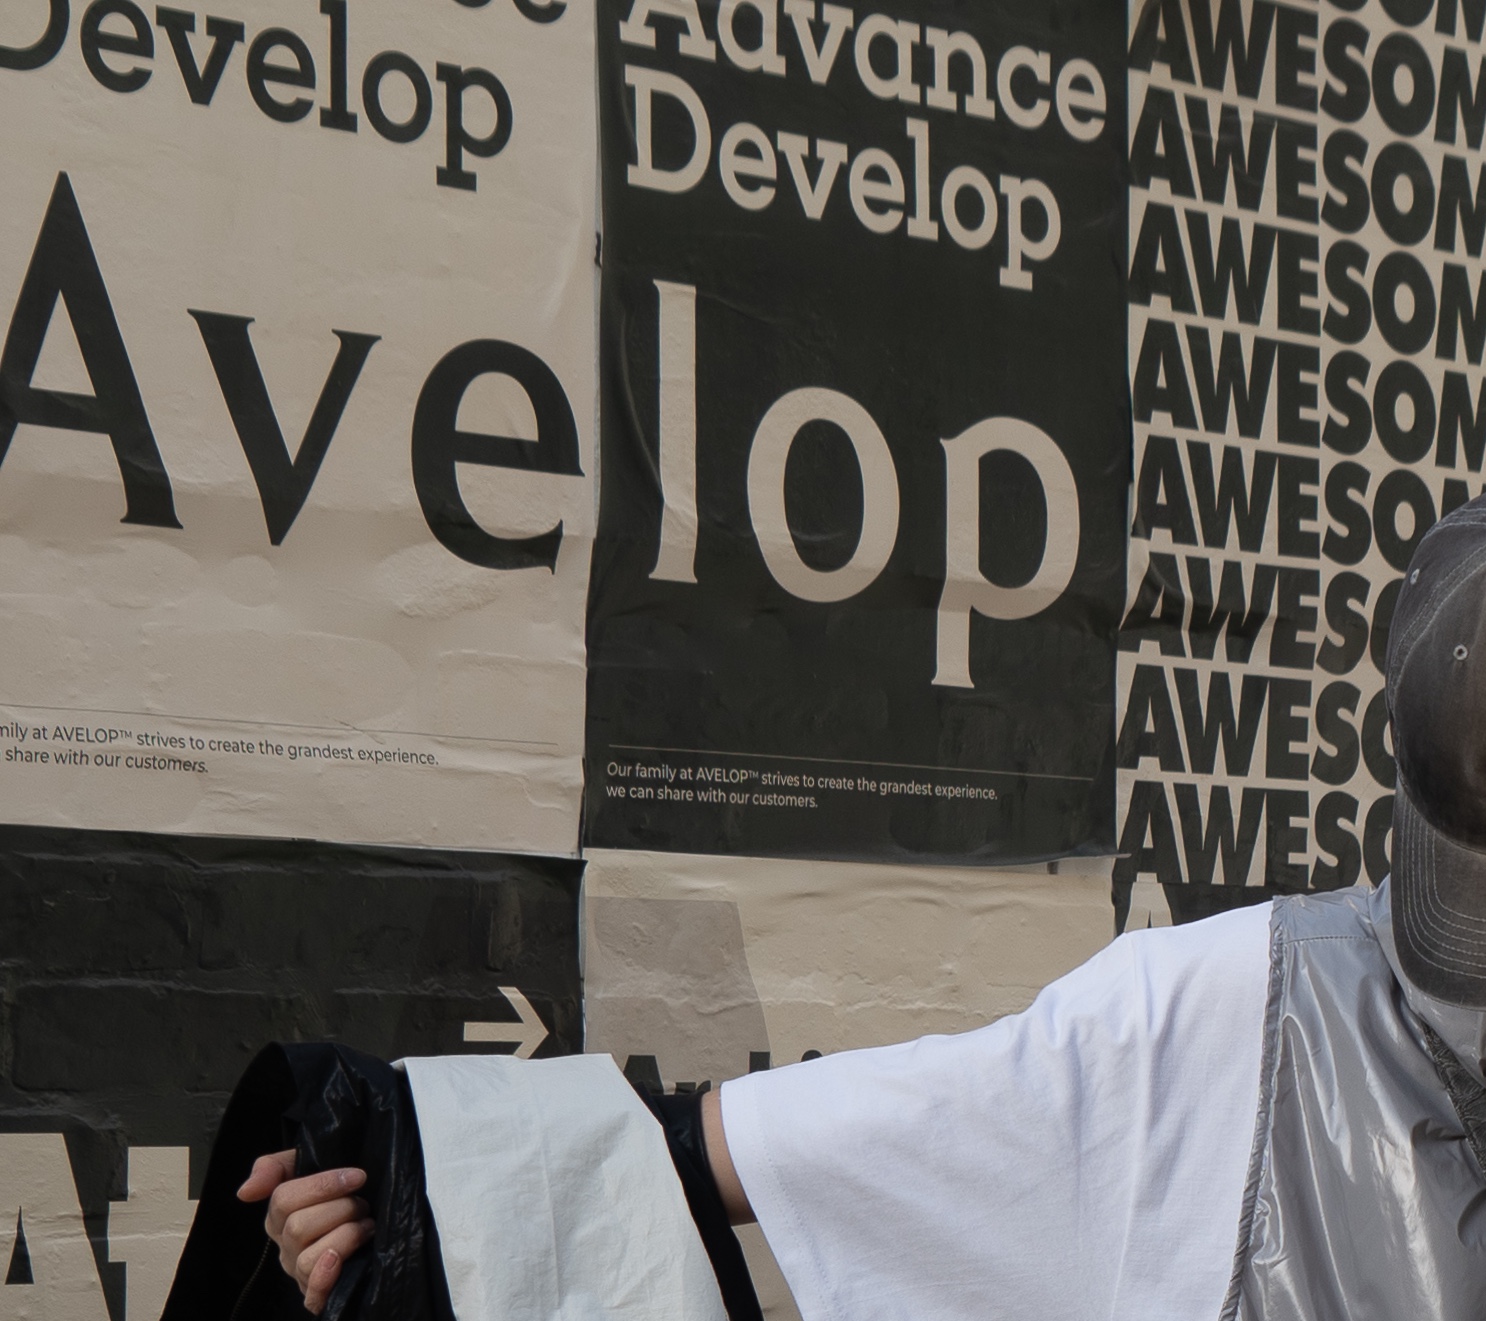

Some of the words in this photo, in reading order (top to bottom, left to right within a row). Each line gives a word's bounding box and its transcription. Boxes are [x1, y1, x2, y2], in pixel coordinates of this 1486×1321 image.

[624, 63, 1062, 291] Develop
[0, 170, 585, 575] Ave
[648, 279, 1081, 689] lop
[1117, 551, 1400, 676] AWES
[5, 746, 49, 764] share
[54, 749, 89, 766] with
[94, 754, 121, 768] our
[125, 754, 209, 774] customers.
[32, 725, 48, 741] at
[137, 731, 186, 749] strives
[189, 736, 205, 751] to
[208, 738, 255, 754] create
[259, 739, 283, 756] the
[287, 744, 354, 760] grandest
[357, 747, 439, 766] experience.
[607, 761, 632, 777] Our
[635, 763, 677, 783] family
[679, 766, 693, 781] at
[761, 772, 800, 788] strives
[803, 774, 815, 788] to
[817, 776, 854, 791] create
[857, 777, 877, 792] the
[879, 780, 932, 796] grandest
[935, 784, 998, 800] experience.
[1116, 663, 1396, 790] AWES
[606, 785, 626, 798] we
[629, 786, 654, 799] can
[657, 785, 694, 801] share
[697, 787, 726, 803] with
[729, 792, 750, 805] our
[752, 792, 819, 809] customers.
[1112, 779, 1395, 889] AWES
